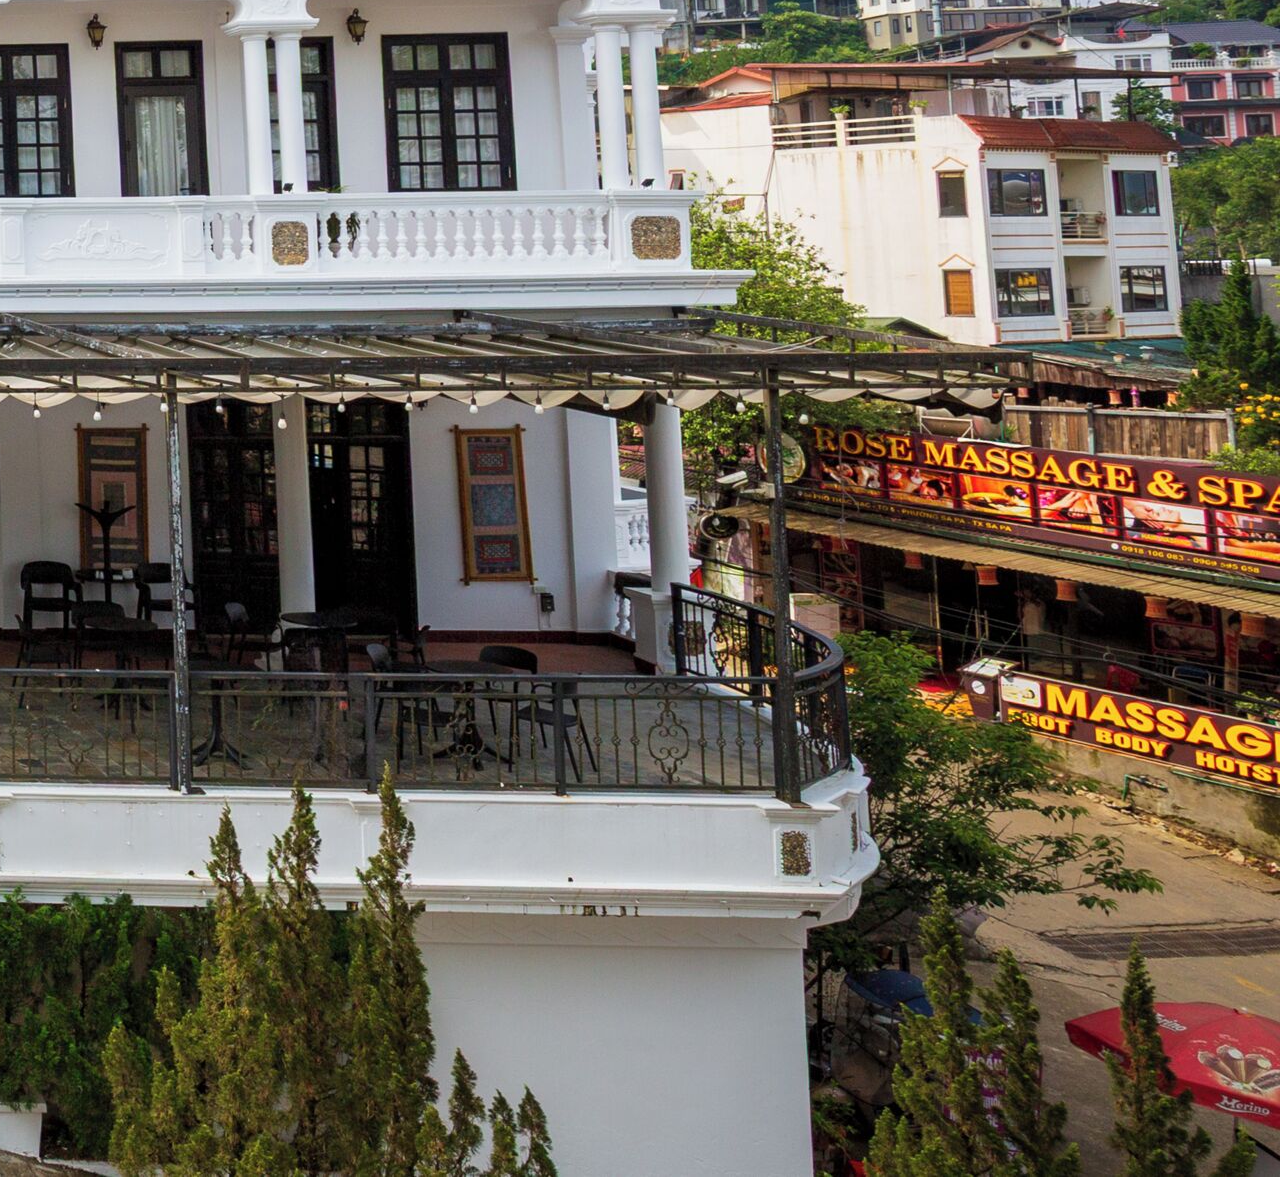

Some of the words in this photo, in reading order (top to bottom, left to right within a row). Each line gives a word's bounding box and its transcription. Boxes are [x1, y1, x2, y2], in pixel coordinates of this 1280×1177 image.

[813, 426, 914, 462] ROSE
[922, 439, 1136, 493] MASSAGE
[1147, 469, 1188, 500] &
[1045, 683, 1280, 763] MASSAG
[1095, 727, 1171, 757] BODY
[1216, 1094, 1271, 1116] Merino
